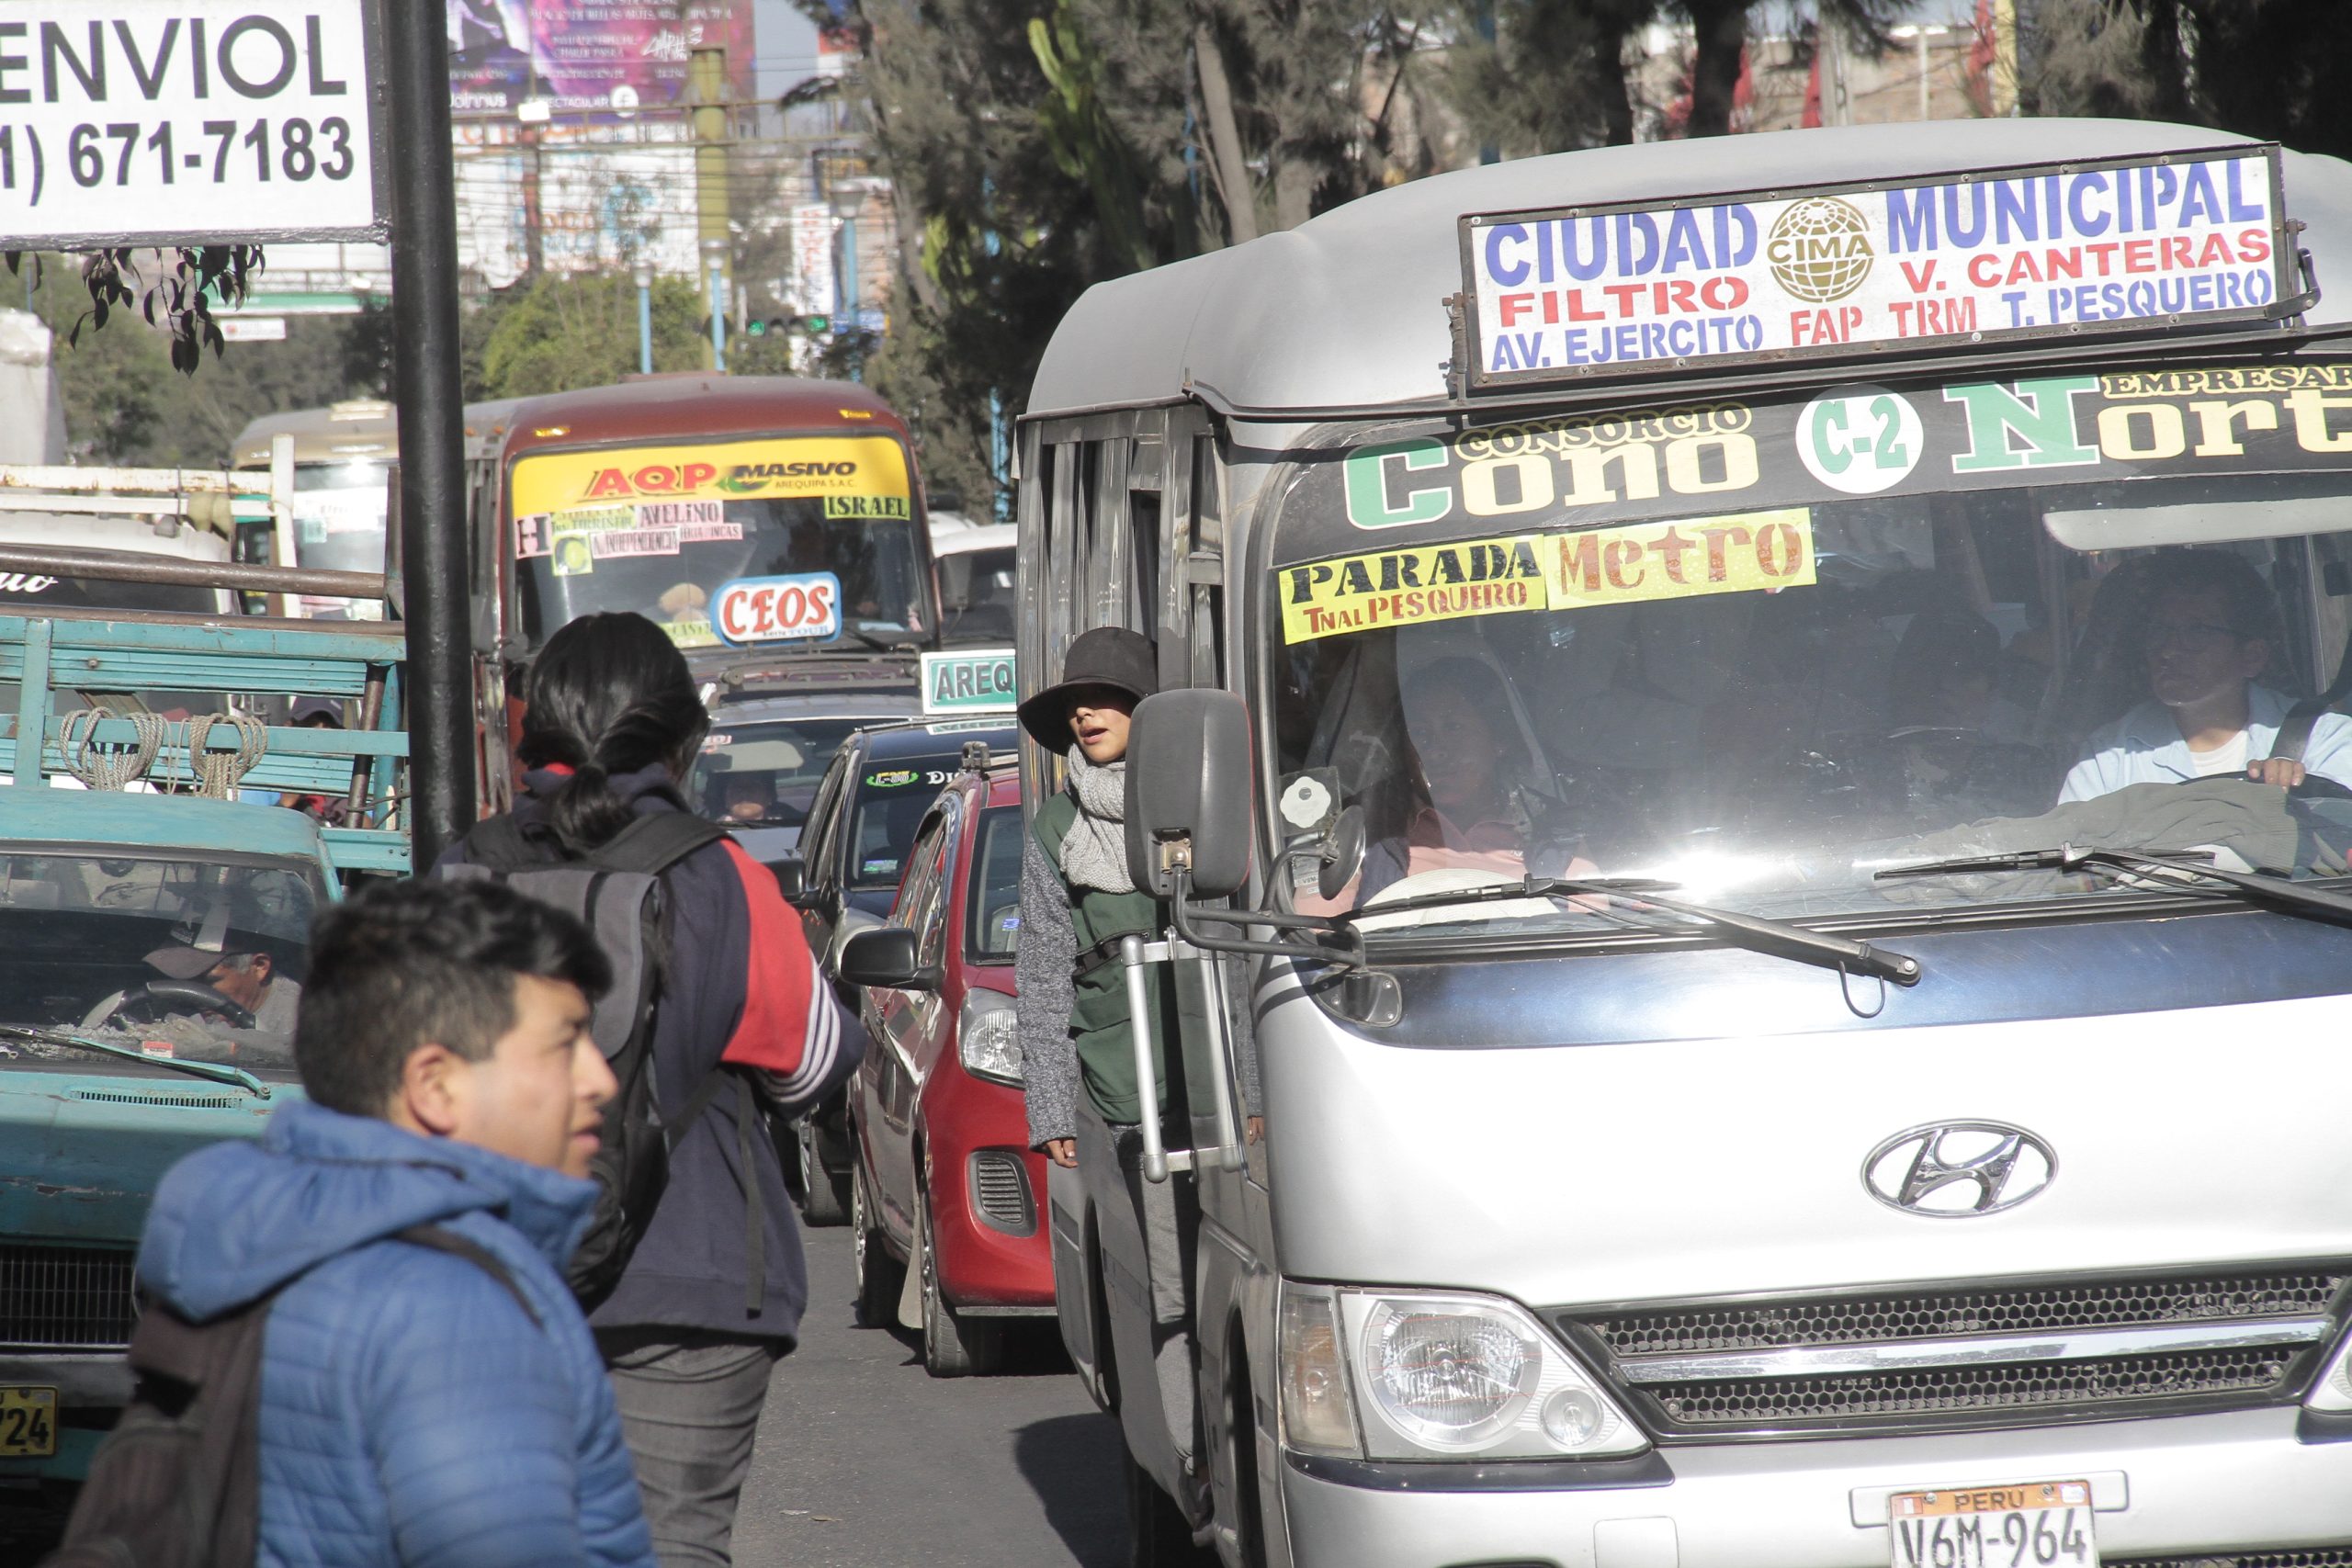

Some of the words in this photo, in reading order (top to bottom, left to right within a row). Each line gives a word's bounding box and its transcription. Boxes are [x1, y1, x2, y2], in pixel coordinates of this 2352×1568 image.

[0, 15, 347, 103] ENVIOL
[69, 117, 355, 187] 671-7183
[1886, 158, 2265, 254] MUNICIPAL
[1485, 203, 1758, 287] CIUDAD
[1767, 234, 1874, 263] CIMA
[1900, 259, 1947, 293] V.
[1967, 229, 2271, 288] CANTERAS
[1492, 333, 1550, 371] AV.
[1565, 314, 1762, 365] EJERCITO
[1790, 307, 1863, 346] FAP
[1889, 296, 1976, 337] TRM
[2001, 292, 2033, 327] T.
[2050, 269, 2272, 323] PESQUERO
[1499, 276, 1749, 327] FILTRO
[1454, 401, 1752, 461] CONSORCIO
[1812, 396, 1908, 475] C-2
[1942, 374, 2352, 474] Nort
[585, 462, 718, 501] AQP
[732, 462, 856, 477] MASIVO
[775, 479, 827, 490] AREQUIPA
[1342, 433, 1759, 531] Cono
[827, 496, 907, 516] ISRAEL
[1291, 542, 1542, 604] PARADA
[1561, 523, 1803, 595] Metro
[723, 586, 830, 635] CEOS
[1368, 582, 1527, 623] PESQUERO
[934, 661, 1013, 701] AREQ
[1954, 1490, 2024, 1513] PERU
[1899, 1508, 2086, 1568] V6M-964
